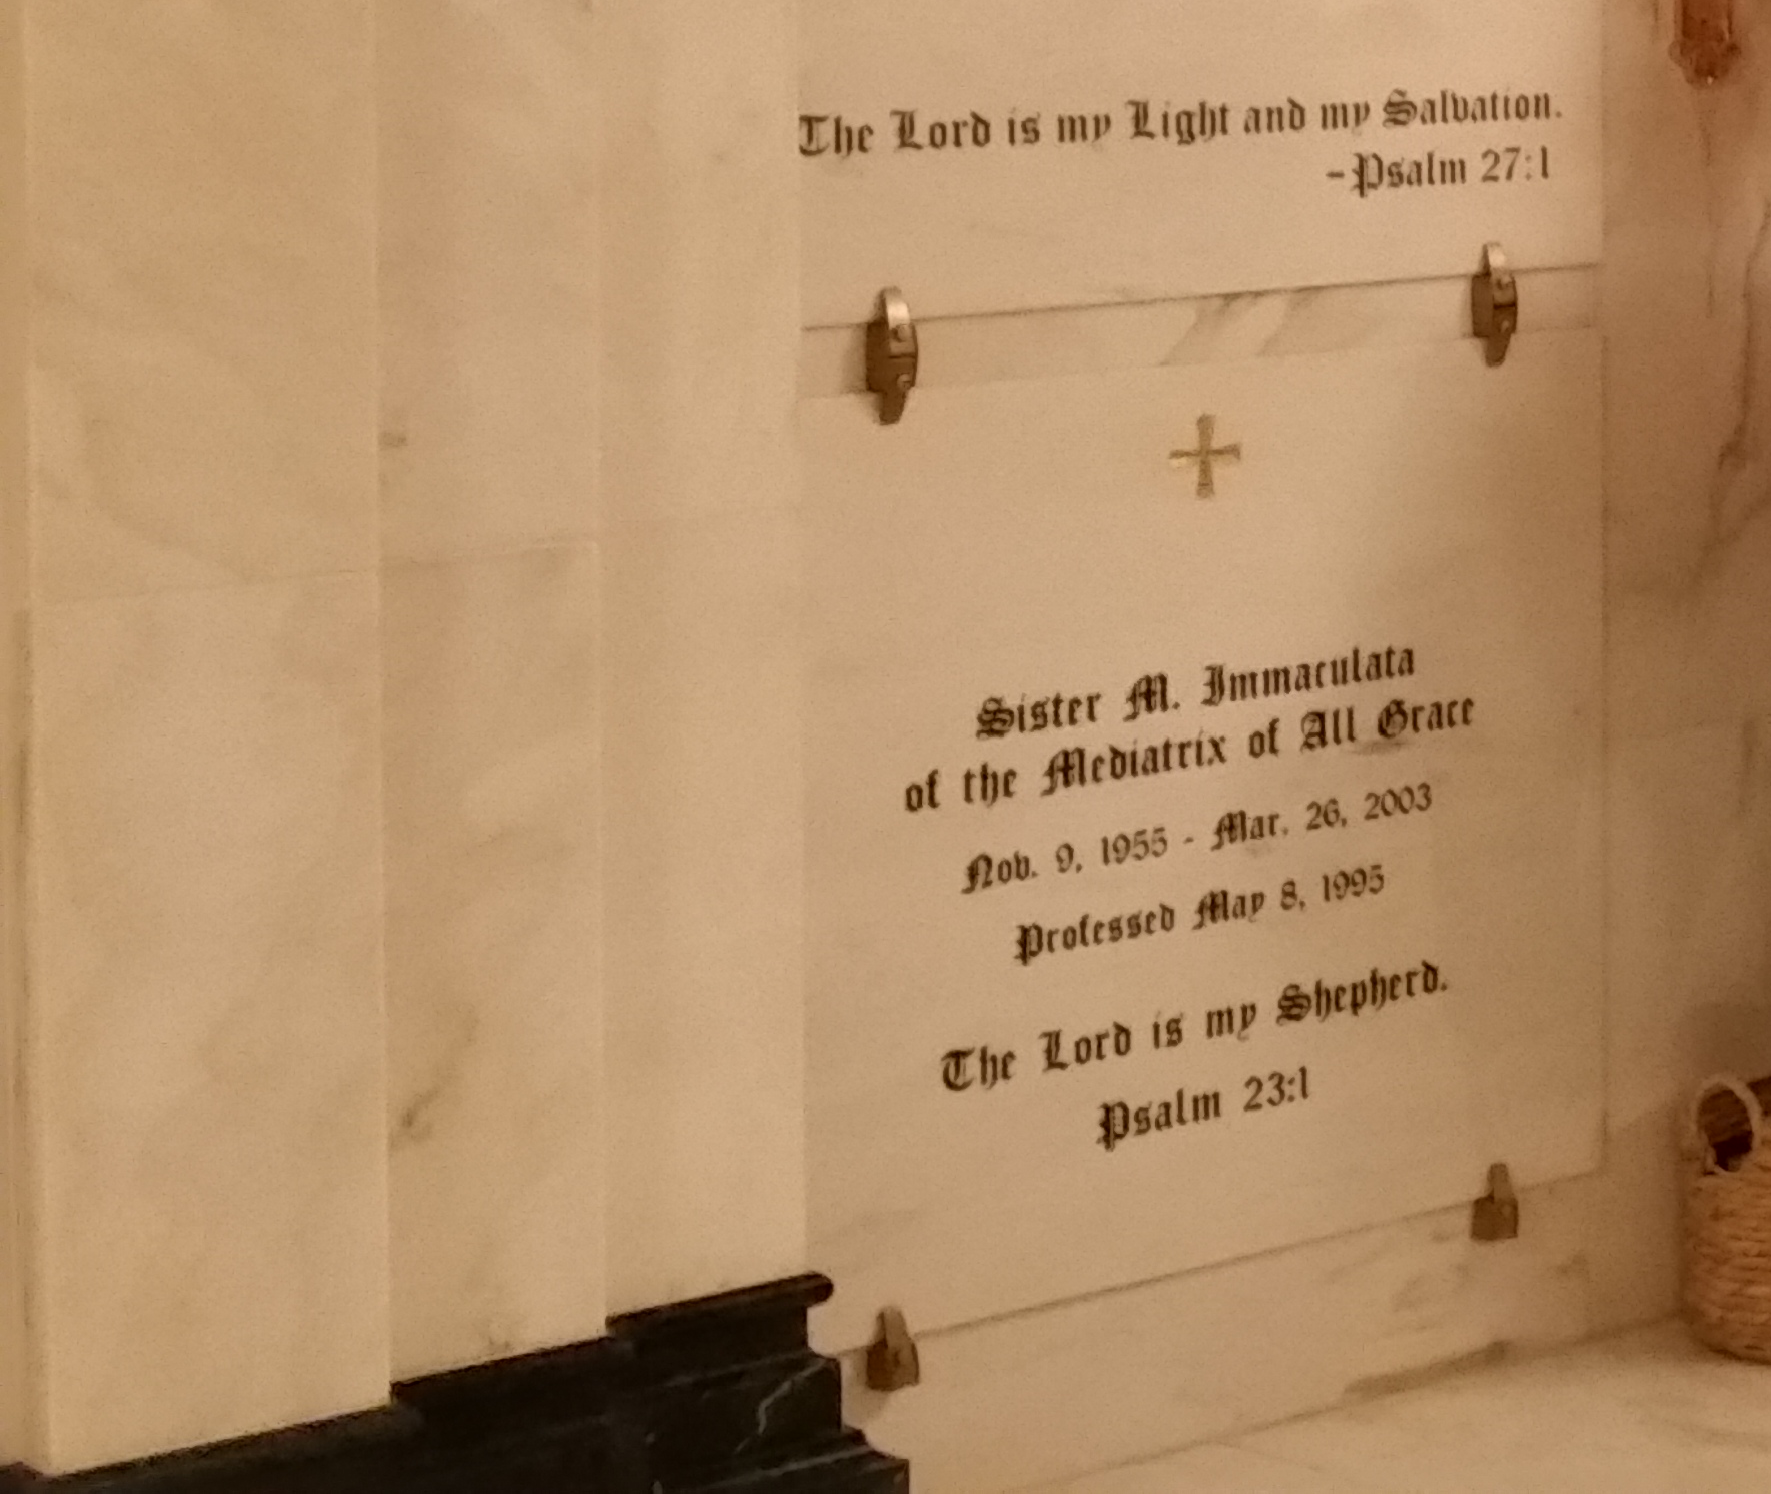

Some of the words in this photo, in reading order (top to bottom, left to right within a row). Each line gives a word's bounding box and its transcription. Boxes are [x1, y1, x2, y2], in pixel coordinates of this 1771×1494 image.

[798, 113, 875, 157] The
[889, 109, 991, 151] Lord
[1005, 107, 1042, 147] is
[1056, 111, 1112, 149] my
[1124, 98, 1230, 146] Light
[1242, 96, 1306, 135] and
[1320, 99, 1371, 134] my
[1381, 88, 1564, 128] Salvation.
[1480, 145, 1550, 184] 27:1
[975, 689, 1103, 741] Sister
[1122, 672, 1181, 721] M.
[1200, 644, 1416, 707] Immaculata
[904, 769, 940, 813] of
[962, 762, 1017, 807] the
[1040, 730, 1228, 798] Mediatrix
[1247, 717, 1281, 759] of
[1299, 707, 1357, 753] All
[1377, 695, 1475, 740] Grace
[961, 852, 1039, 895] Nov.
[1099, 827, 1168, 866] 1955
[1209, 808, 1290, 851] Mar.
[1363, 782, 1434, 822] 2003
[1014, 904, 1176, 966] Professed
[1192, 888, 1265, 932] May
[1320, 864, 1386, 903] 1995
[940, 1046, 1016, 1092] The
[1038, 1021, 1132, 1073] Lord
[1151, 1010, 1184, 1050] is
[1204, 1002, 1258, 1043] my
[1275, 960, 1450, 1026] Shepherd.
[1095, 1088, 1223, 1153] Psalm
[1243, 1066, 1311, 1115] 23:1
